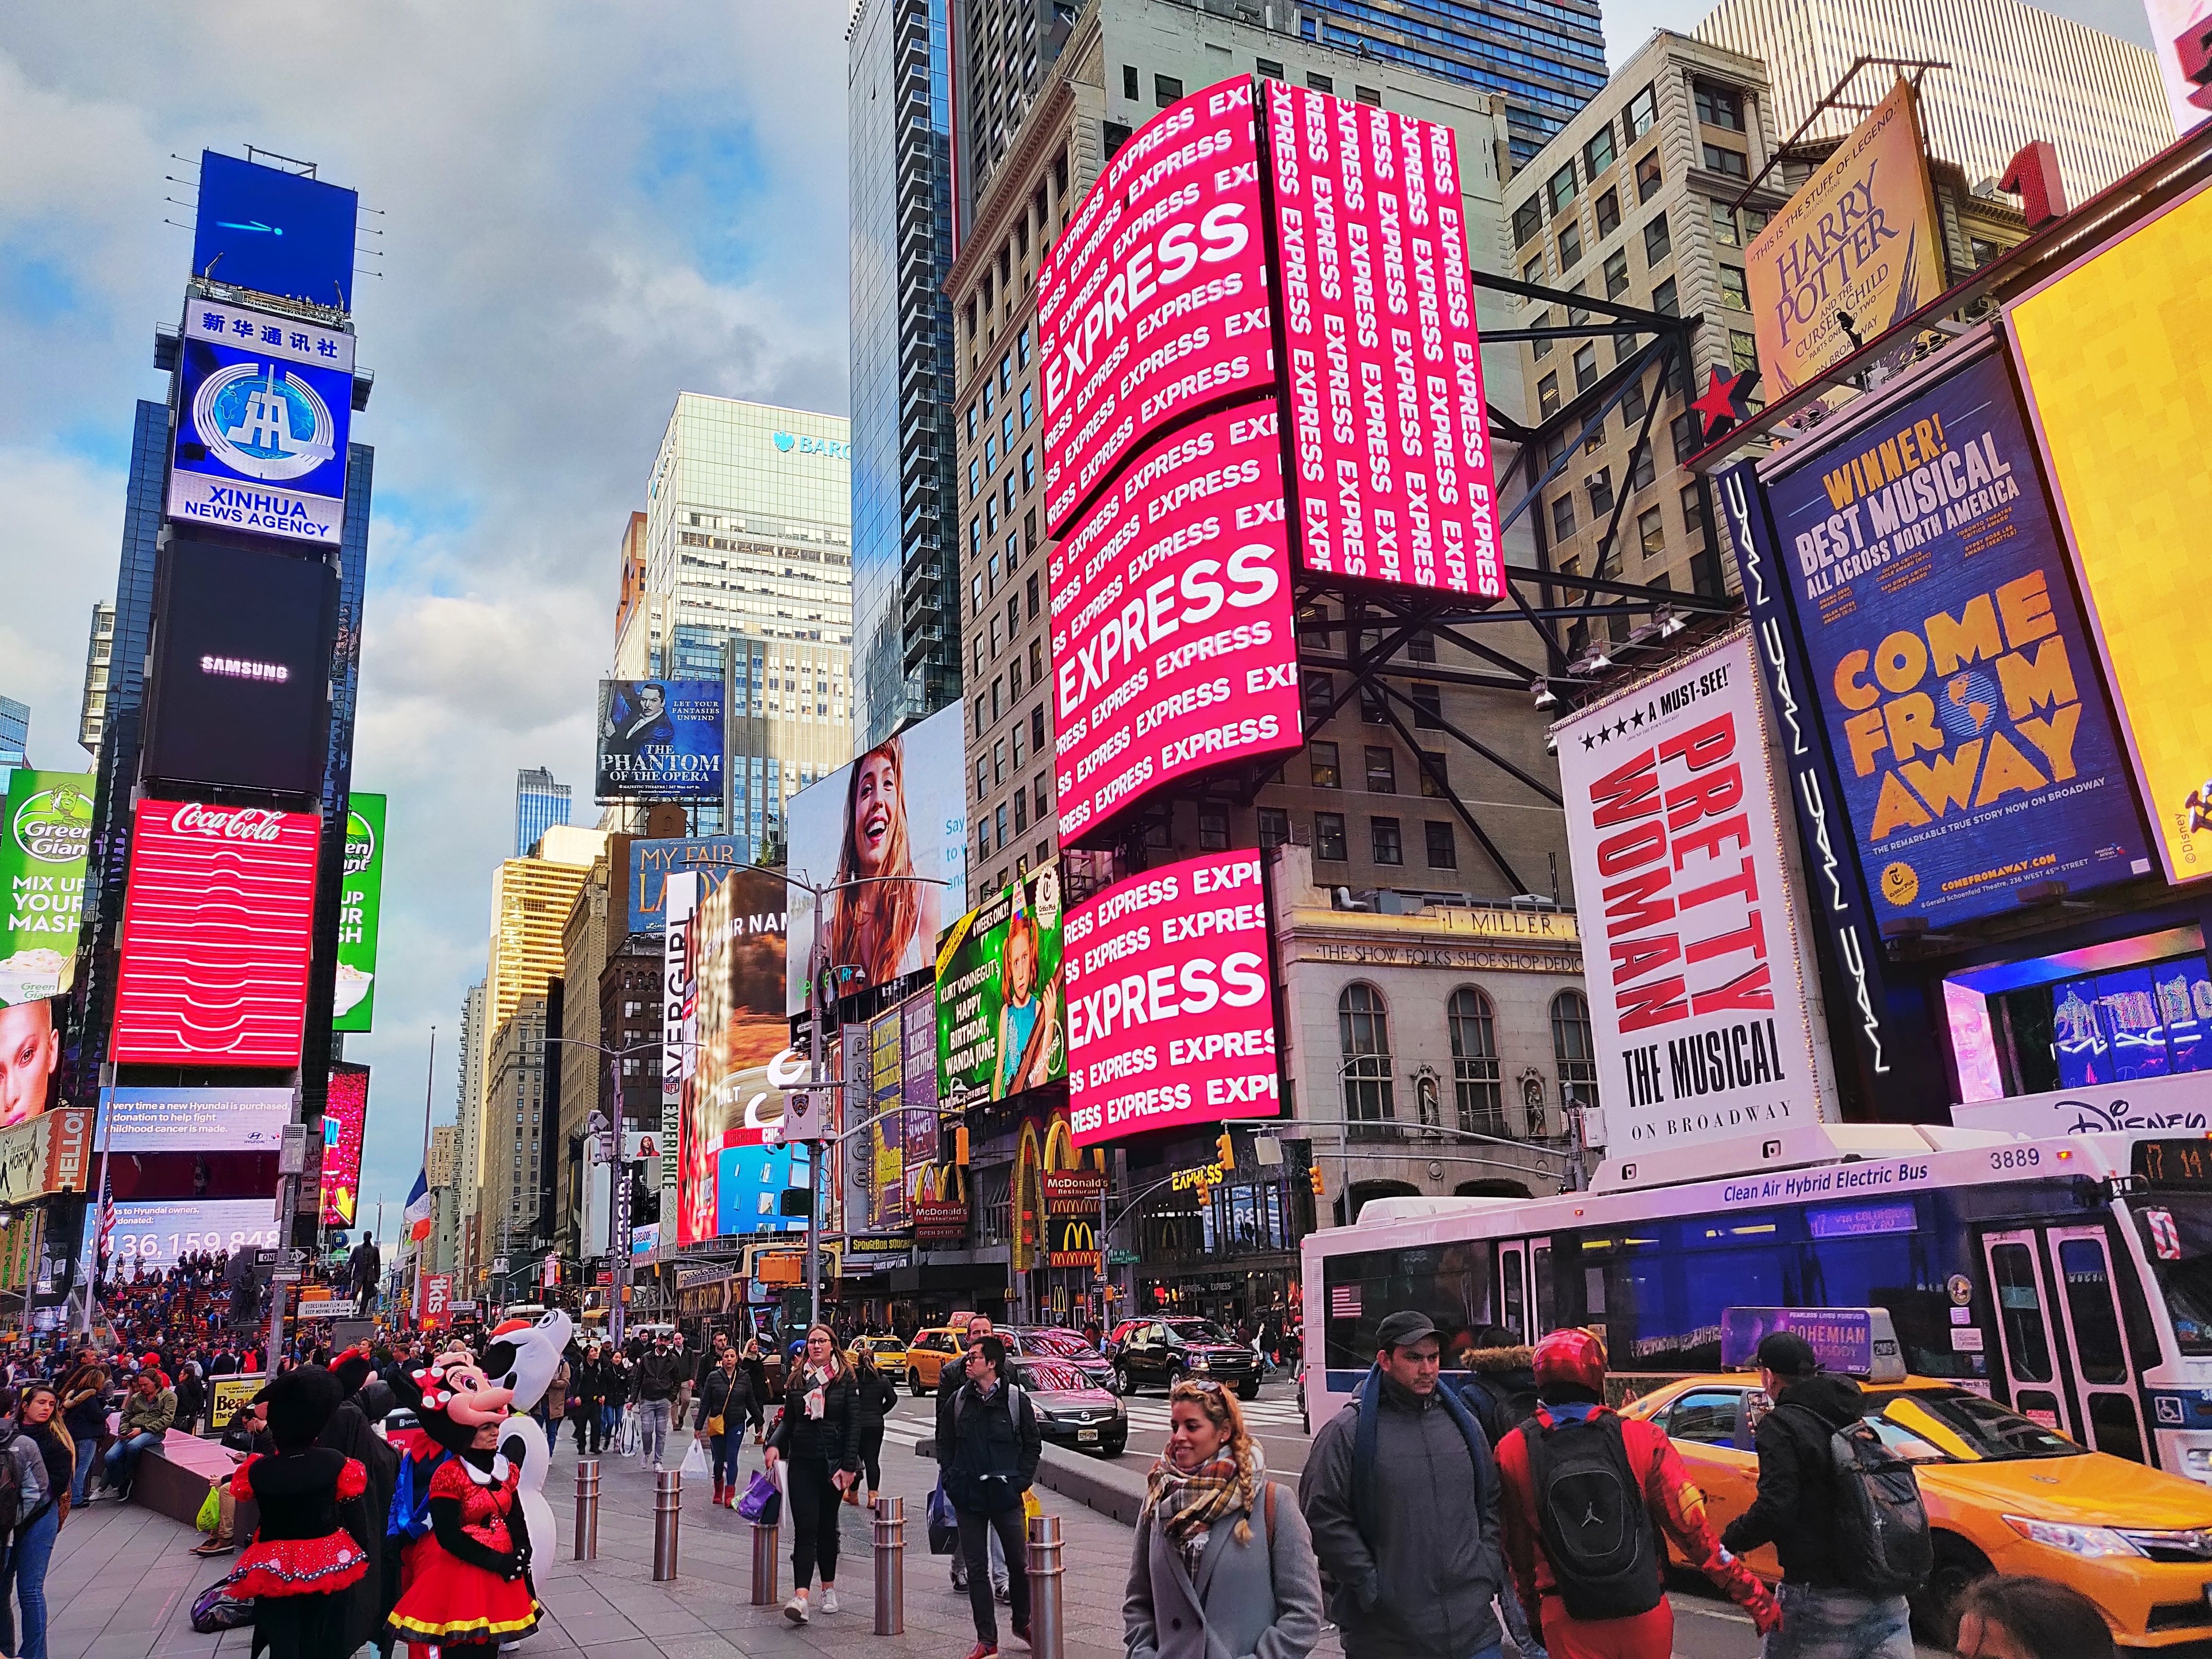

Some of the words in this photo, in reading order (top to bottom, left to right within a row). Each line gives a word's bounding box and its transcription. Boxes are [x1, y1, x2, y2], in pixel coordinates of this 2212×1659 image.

[1775, 229, 1784, 241] IS
[1784, 206, 1804, 230] THE
[1805, 172, 1834, 208] STUFF
[1836, 156, 1851, 174] OF
[1824, 179, 1840, 200] STONE
[1775, 158, 1878, 299] HARRY
[1281, 206, 1312, 336] EXPRESS
[1347, 222, 1379, 349] EXPRESS
[1775, 206, 1901, 349] POTTER
[1046, 202, 1250, 418] EXPRESS
[1136, 272, 1243, 343] EXPRESS
[1795, 308, 1842, 359] CURSED
[1846, 262, 1888, 312] CHILD
[1820, 299, 1837, 320] AND
[1838, 282, 1854, 303] THE
[203, 312, 338, 359] 新华通讯社
[1809, 343, 1827, 361] PARTS
[1828, 326, 1843, 345] ONE
[1859, 294, 1876, 313] TWO
[1293, 348, 1325, 483] EXPRESS
[1822, 413, 1948, 511] WINNER!
[185, 500, 243, 523] NEWS
[248, 511, 330, 537] AGENCY
[208, 485, 308, 521] XINHUA
[1795, 504, 1864, 577] BEST
[1866, 431, 2011, 539] MUSICAL
[1985, 506, 2013, 524] THEATRE
[1987, 514, 2009, 529] AWARD
[1806, 566, 1833, 601] ALL
[1835, 539, 1892, 587] ACROSS
[1893, 514, 1943, 557] NORTH
[1947, 475, 2020, 530] AMERICA
[1058, 543, 1279, 719] EXPRESS
[1834, 569, 2058, 711] COME
[202, 656, 288, 679] SAMSUNG
[1647, 701, 1658, 723] A
[599, 753, 720, 772] PHANTOM
[645, 744, 674, 755] THE
[610, 771, 632, 781] OF
[634, 770, 661, 781] THE
[662, 770, 709, 782] OPERA
[1870, 703, 2083, 841] AWAY
[946, 816, 965, 835] Say
[1873, 842, 1890, 855] THE
[1890, 824, 1947, 852] REMARKABLE
[1947, 818, 1972, 835] TRUE
[1973, 808, 2004, 829] STORY
[2005, 801, 2030, 816] NOW
[2031, 794, 2047, 806] ON
[2047, 776, 2106, 804] BROADWAY
[640, 847, 678, 871] MY
[946, 847, 957, 862] to
[1658, 711, 1776, 1017] PRETTY
[1941, 853, 2057, 892] COMEFROMAWAY.COM
[12, 875, 54, 891] MIX
[1098, 876, 1179, 927] EXPRESS
[1588, 746, 1690, 1034] WOMAN
[1925, 895, 1946, 908] Gerald
[1946, 885, 1981, 902] Schoenfeld
[1981, 878, 2008, 894] Theatre,
[2009, 875, 2021, 885] 236
[2022, 869, 2045, 882] WEST
[2045, 866, 2060, 876] 45TH
[2061, 858, 2089, 873] STREET
[973, 926, 977, 937] 6
[976, 914, 993, 937] WEEKS
[993, 901, 1010, 925] ONLY!
[1472, 913, 1555, 936] MILLER
[938, 924, 966, 977] ENGAGEMENT
[942, 923, 960, 958] LIMITED
[1084, 925, 1152, 976] EXPRESS
[1319, 944, 1349, 960] THE
[1355, 946, 1398, 962] SHOW
[1406, 949, 1453, 965] FOLKS
[1458, 951, 1498, 968] SHOE
[1501, 954, 1539, 969] SHOP
[21, 982, 56, 991] Green
[940, 979, 958, 1005] KURT
[1067, 951, 1266, 1052] EXPRESS
[955, 992, 982, 1023] HAPPY
[950, 1014, 990, 1051] BIRTHDAY,
[944, 1047, 975, 1078] WANDA
[975, 1037, 996, 1070] JUNE
[1028, 1036, 1061, 1084] WHEELHOUSE
[1089, 1045, 1158, 1089] EXPRESS
[1622, 1044, 1665, 1108] THE
[1668, 1017, 1786, 1100] MUSICAL
[135, 1102, 157, 1110] time
[190, 1102, 229, 1112] Hyundai
[229, 1102, 238, 1110] is
[239, 1102, 290, 1112] purchased,
[664, 1083, 679, 1094] NFL
[1107, 1083, 1192, 1125] EXPRESS
[113, 1113, 157, 1122] donation
[158, 1114, 169, 1122] to
[170, 1112, 192, 1123] help
[193, 1112, 216, 1123] fight
[189, 1124, 196, 1133] is
[198, 1124, 228, 1133] made.
[852, 1037, 866, 1186] PALACE
[1632, 1123, 1657, 1141] ON
[1668, 1100, 1792, 1136] BROADWAY
[57, 1112, 85, 1187] HELLO!
[662, 1104, 679, 1190] EXPERIENCE
[1990, 1148, 2040, 1170] 3889
[1047, 1178, 1108, 1188] McDonald's
[1724, 1186, 1758, 1202] Clean
[1762, 1180, 1781, 1197] Air
[1785, 1173, 1831, 1198] Hybrid
[1836, 1166, 1892, 1189] Electric
[1898, 1163, 1928, 1181] Bus
[133, 1207, 167, 1216] Hyundai
[168, 1206, 200, 1214] owners,
[916, 1207, 967, 1216] McDonald's
[853, 1239, 888, 1251] SPONGEBOB
[427, 1277, 448, 1314] tkts
[1211, 1282, 1231, 1291] EXPRESS
[1789, 1325, 1866, 1344] BOHEMIAN
[399, 1418, 420, 1427] Bigbelly
